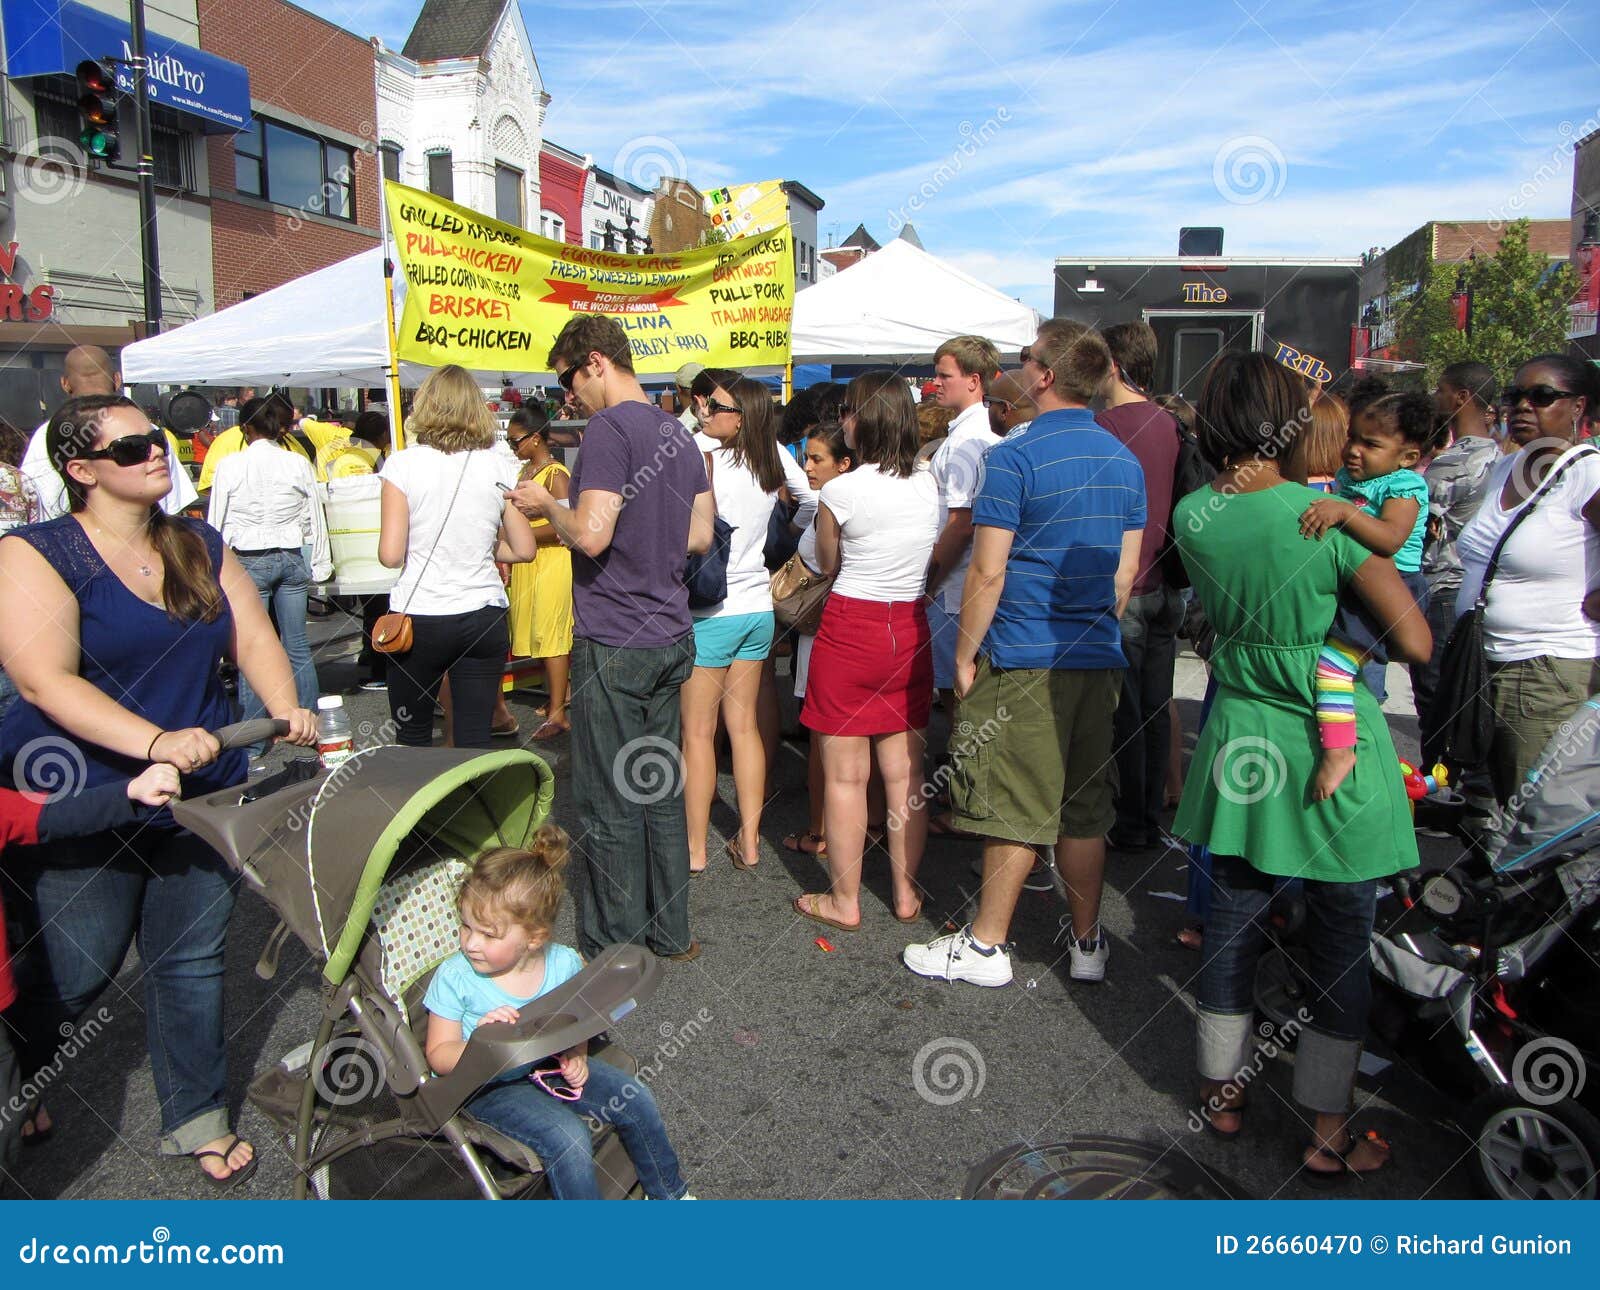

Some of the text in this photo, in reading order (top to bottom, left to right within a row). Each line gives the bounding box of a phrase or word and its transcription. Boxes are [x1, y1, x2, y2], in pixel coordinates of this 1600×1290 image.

[400, 203, 464, 234] GRILLED
[451, 245, 523, 275] CHICKEN
[560, 246, 684, 270] FUNNEL CAKE
[406, 263, 448, 286] GRILLED
[450, 268, 477, 291] CORN
[550, 260, 587, 280] FRESH
[589, 268, 644, 286] SQUEEZED
[713, 261, 777, 283] BRATWURST
[595, 293, 642, 303] HOME OF
[753, 283, 785, 301] PORK
[1182, 283, 1227, 304] The
[428, 293, 512, 321] BRISKET
[571, 300, 659, 312] THE WORLD'S FAMOUS
[710, 306, 792, 326] ITALIAN SAUSAGE
[415, 321, 532, 351] BBQ-CHICKEN
[1275, 342, 1334, 384] Rib
[1430, 888, 1455, 904] Jeep
